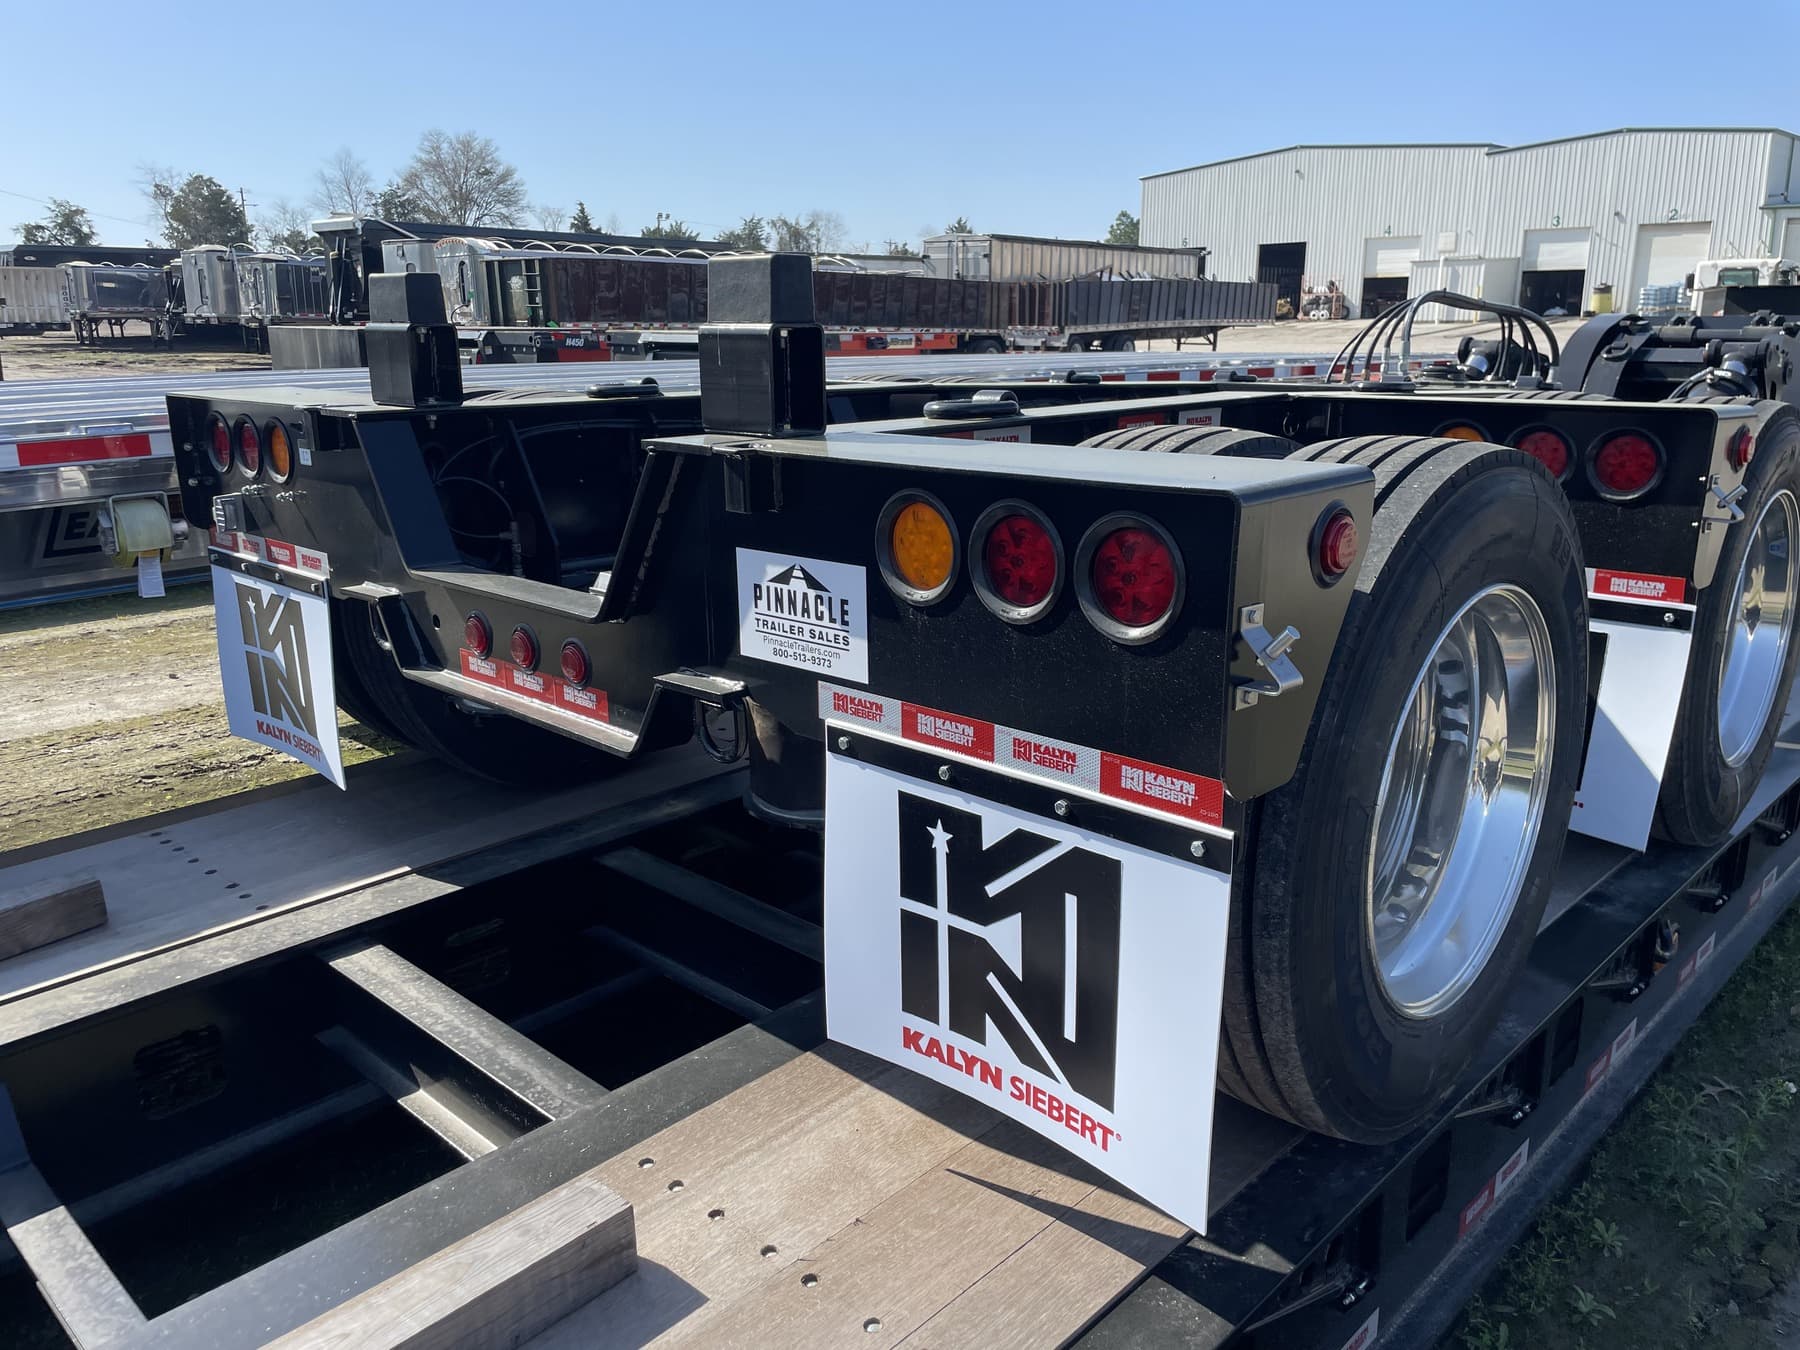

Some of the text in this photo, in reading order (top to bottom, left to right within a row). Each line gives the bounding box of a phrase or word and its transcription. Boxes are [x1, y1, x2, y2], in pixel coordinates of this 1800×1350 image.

[1552, 215, 1560, 227] 3
[1669, 208, 1679, 220] 2
[1383, 224, 1392, 236] 4
[1627, 587, 1664, 597] SIEBERT
[1628, 579, 1665, 591] KALYN
[753, 583, 850, 627] PINNACLE
[755, 618, 850, 646] TRAILER SALES
[763, 635, 841, 659] PinnacleTrailers.com
[773, 647, 832, 668] 800-513-9373
[849, 696, 884, 714] KALYN
[849, 706, 884, 723] SIEBERT
[256, 719, 292, 746] KALYN
[935, 717, 975, 737] KALYN
[935, 730, 975, 747] SIEBERT
[1033, 742, 1077, 764] KALYN
[1033, 754, 1077, 775] SIEBERT
[1145, 771, 1197, 795] KALYN
[1144, 784, 1195, 808] SIEBERT
[902, 1026, 1003, 1092] KALYN
